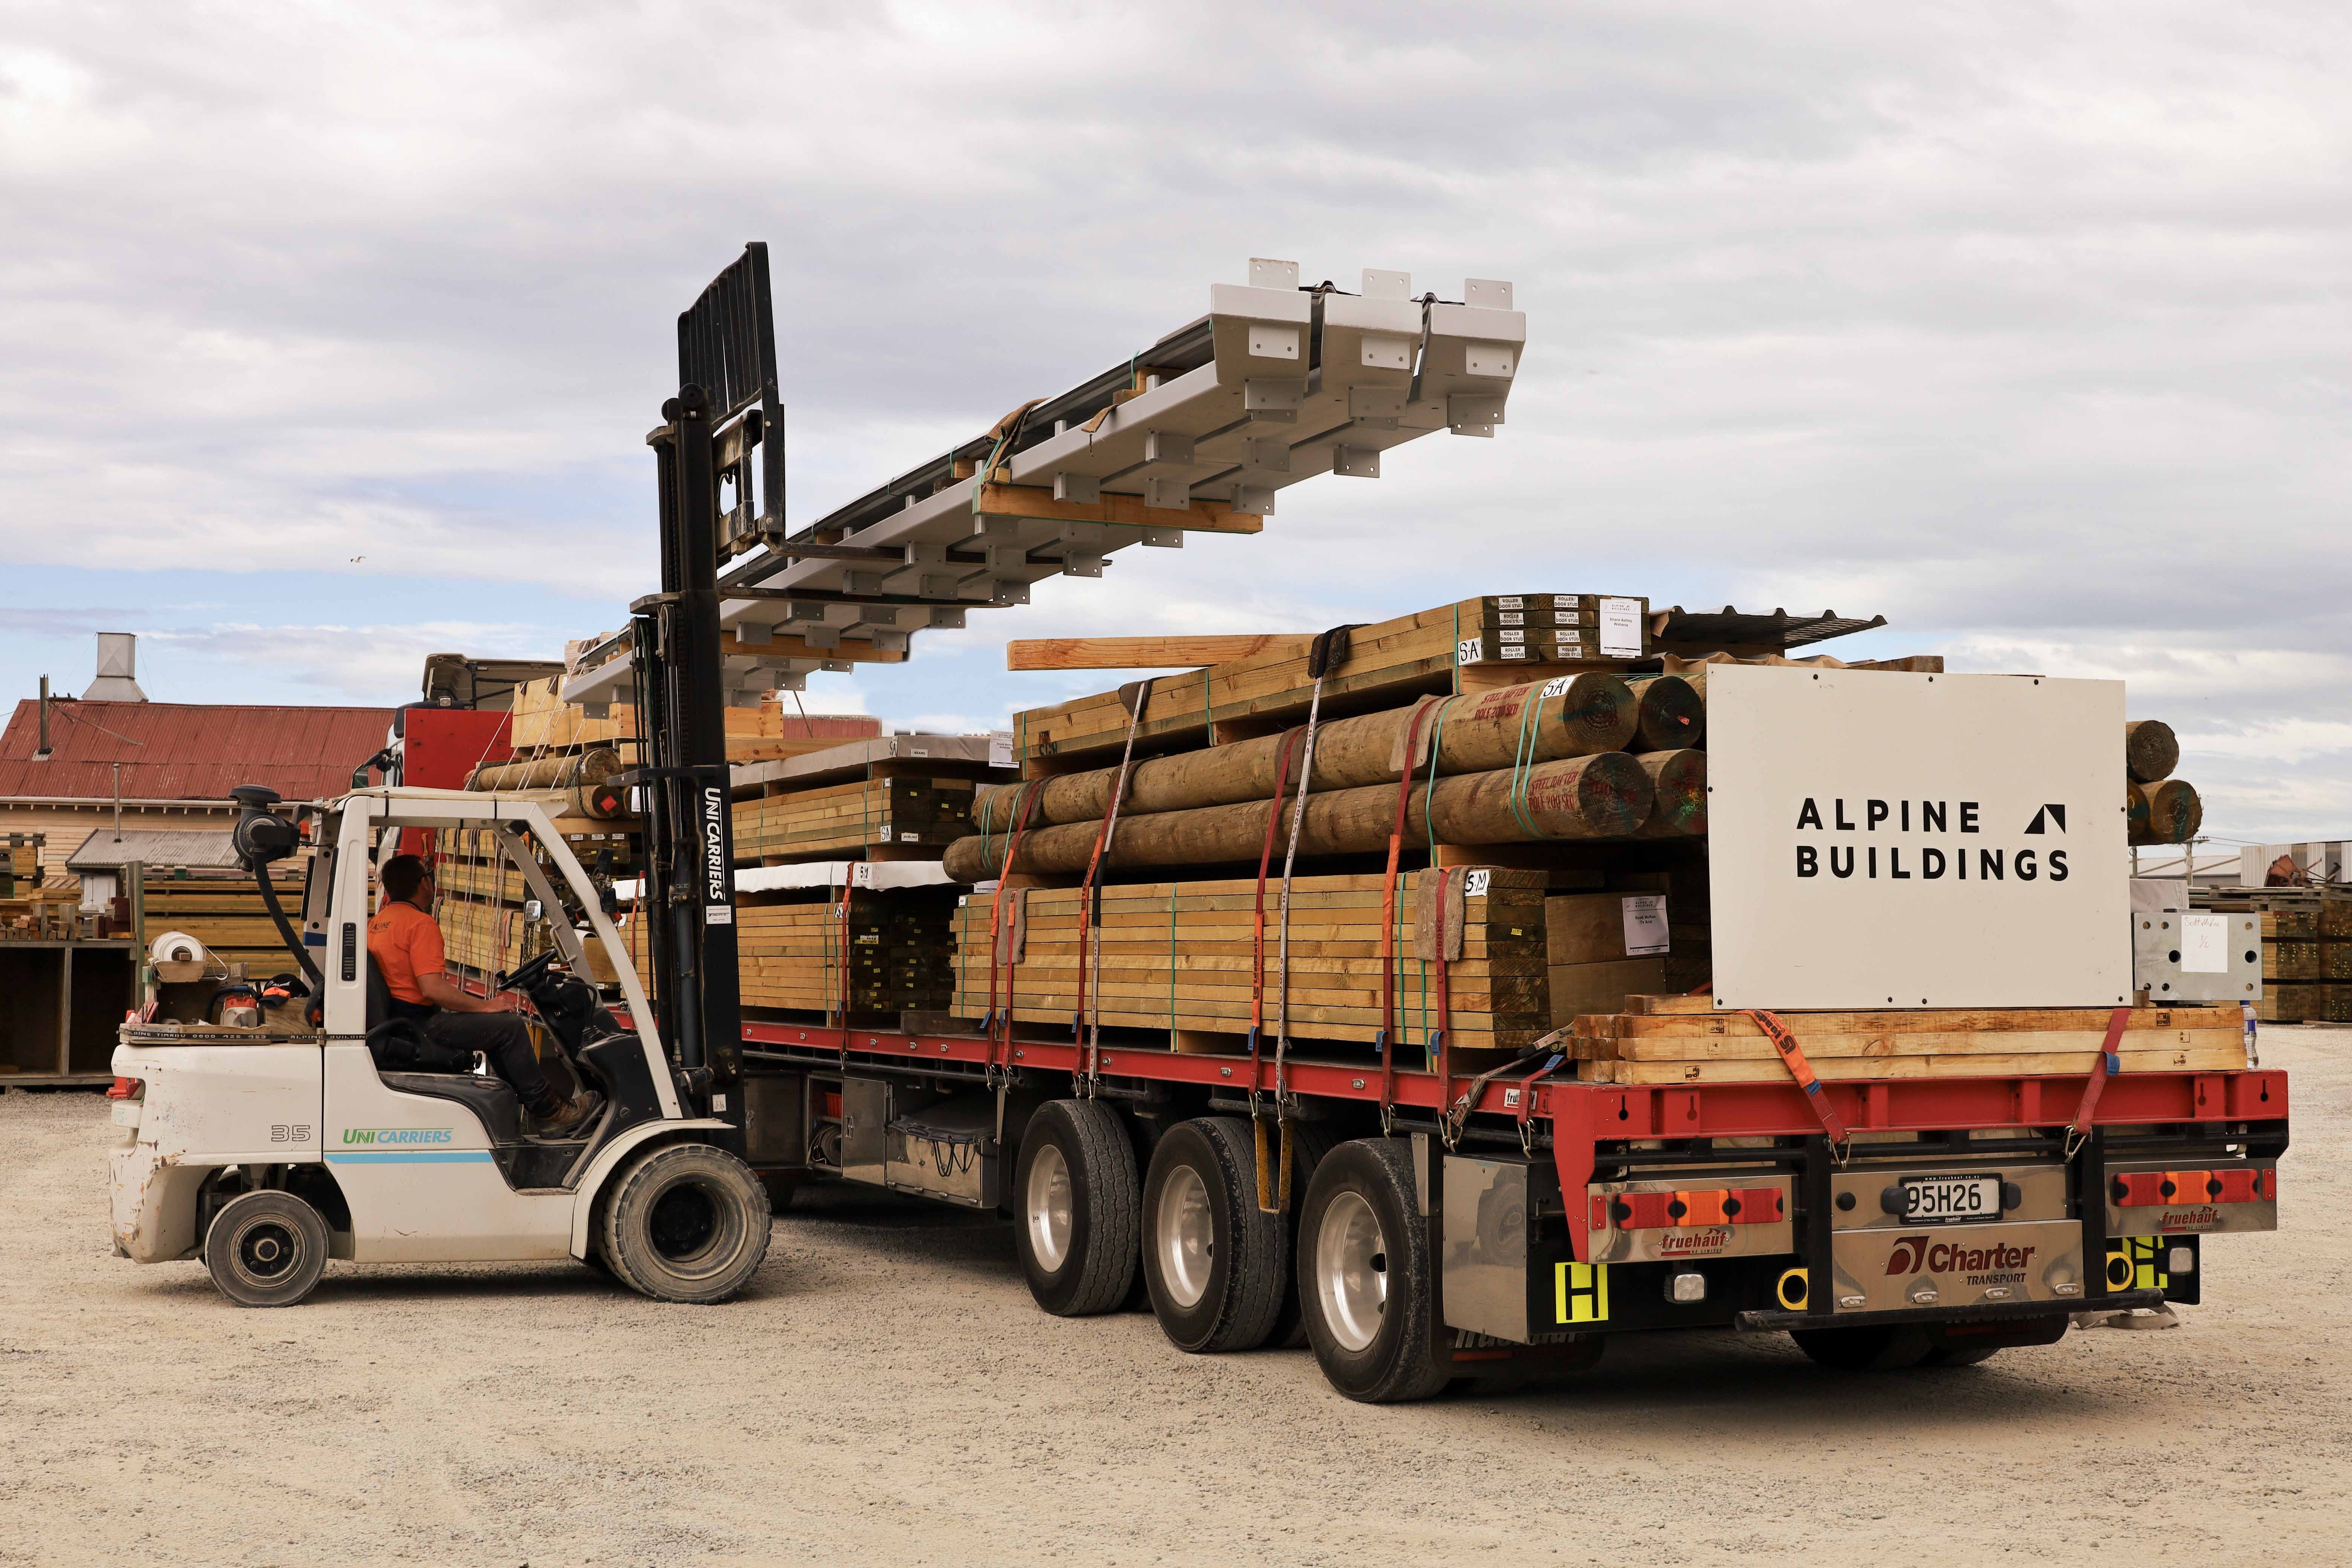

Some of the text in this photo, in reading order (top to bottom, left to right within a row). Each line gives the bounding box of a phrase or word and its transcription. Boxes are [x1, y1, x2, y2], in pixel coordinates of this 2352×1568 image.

[1481, 692, 1503, 704] STEEL
[1288, 790, 1304, 859] LC2500KG
[1796, 798, 1980, 833] ALPINE
[705, 787, 724, 900] UNICARRIERS
[1796, 845, 2069, 882] BUILDINGS
[1438, 968, 1443, 984] LC
[271, 1125, 311, 1142] 35
[1908, 1184, 1981, 1214] 95H26
[2163, 1210, 2218, 1224] fruehauf
[1662, 1232, 1726, 1249] fruehauf
[1928, 1242, 2035, 1273] Charter
[1565, 1263, 1599, 1320] H
[1967, 1273, 2026, 1285] TRANSPORT
